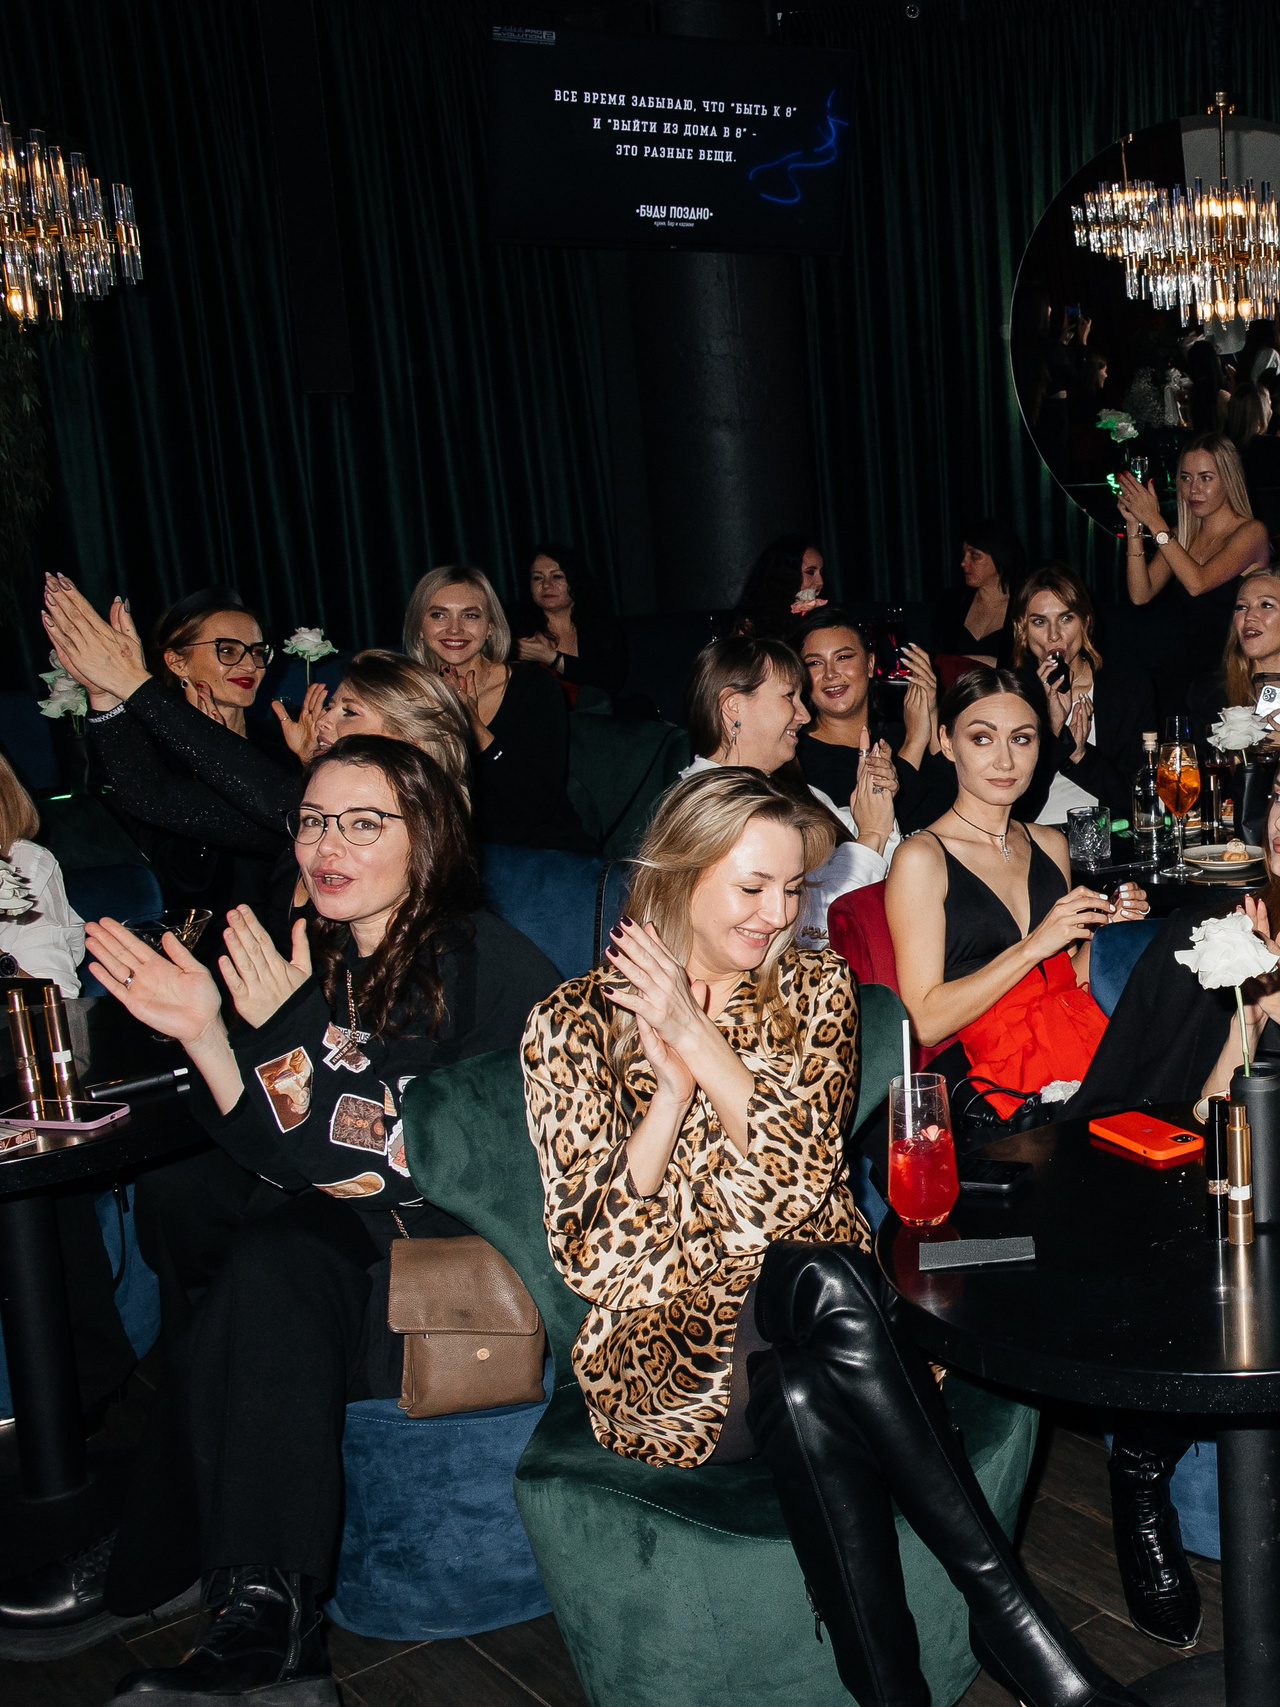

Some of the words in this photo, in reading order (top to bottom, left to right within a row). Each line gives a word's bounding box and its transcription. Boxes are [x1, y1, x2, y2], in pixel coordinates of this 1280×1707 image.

[554, 89, 578, 103] ВСЕ
[583, 91, 626, 106] ВРЕМЯ
[631, 95, 697, 113] ЗАБЫВАЮ,
[702, 100, 725, 113] ЧТО
[730, 102, 768, 116] "БЫТЬ
[773, 105, 781, 117] К
[592, 117, 602, 130] И
[607, 118, 658, 133] "ВЫЙТИ
[662, 122, 679, 135] ИЗ
[683, 123, 718, 137] ДОМА
[722, 126, 730, 138] В
[615, 144, 638, 157] ЭТО
[643, 145, 694, 160] РАЗНЫЕ
[698, 149, 737, 163] ВЕЩИ.
